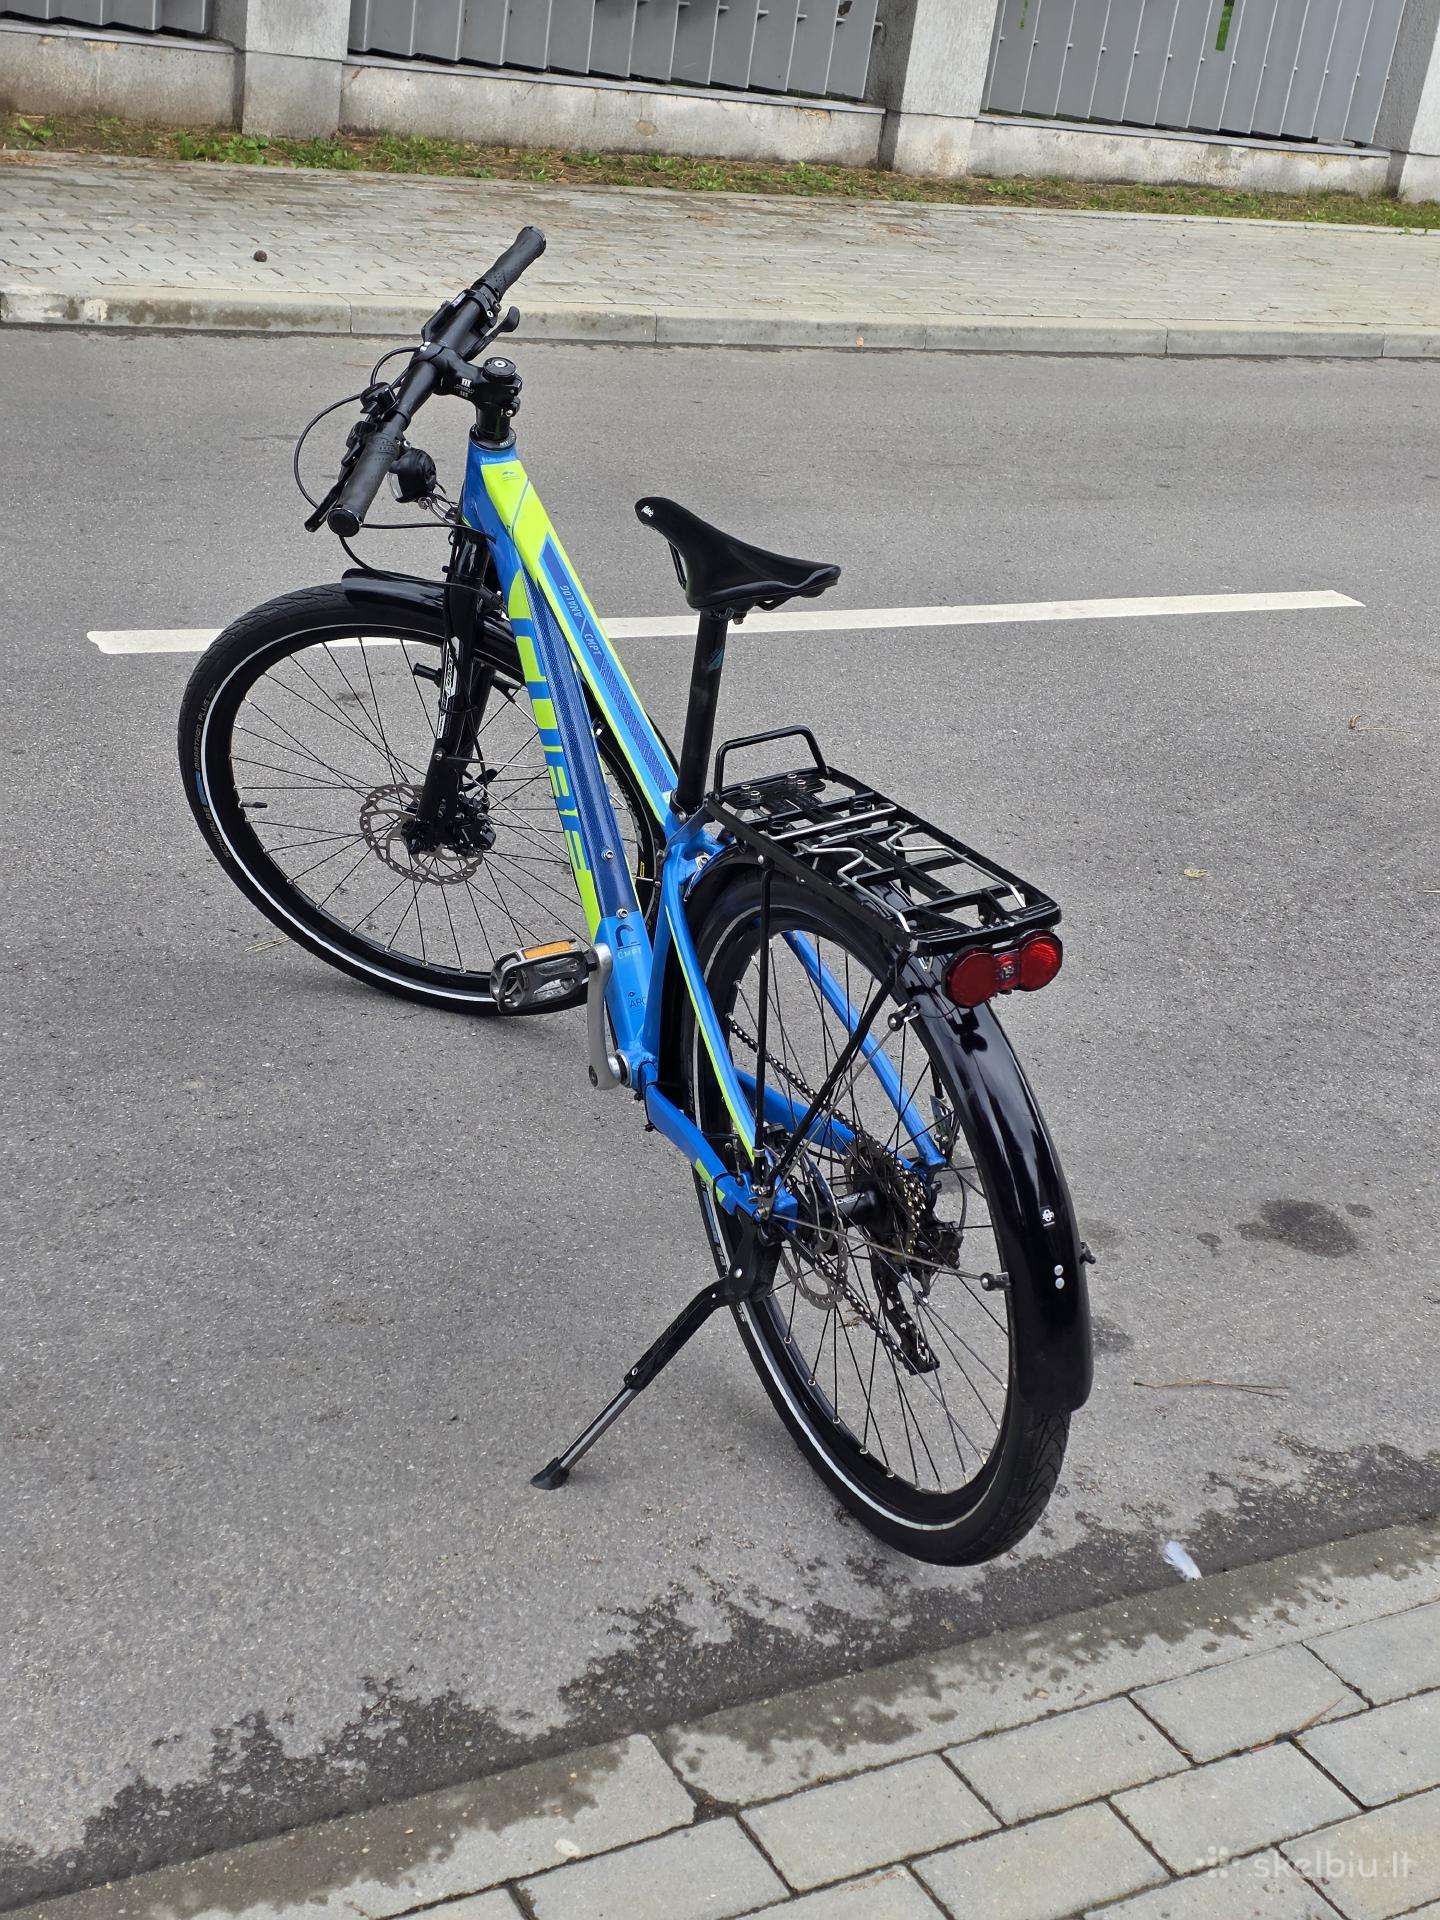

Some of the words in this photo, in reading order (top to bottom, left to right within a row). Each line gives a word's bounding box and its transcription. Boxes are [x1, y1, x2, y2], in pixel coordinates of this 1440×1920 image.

[560, 585, 583, 619] ANALOG
[584, 632, 603, 657] CMPT
[194, 721, 202, 770] MARATHON
[198, 697, 211, 721] PLUS
